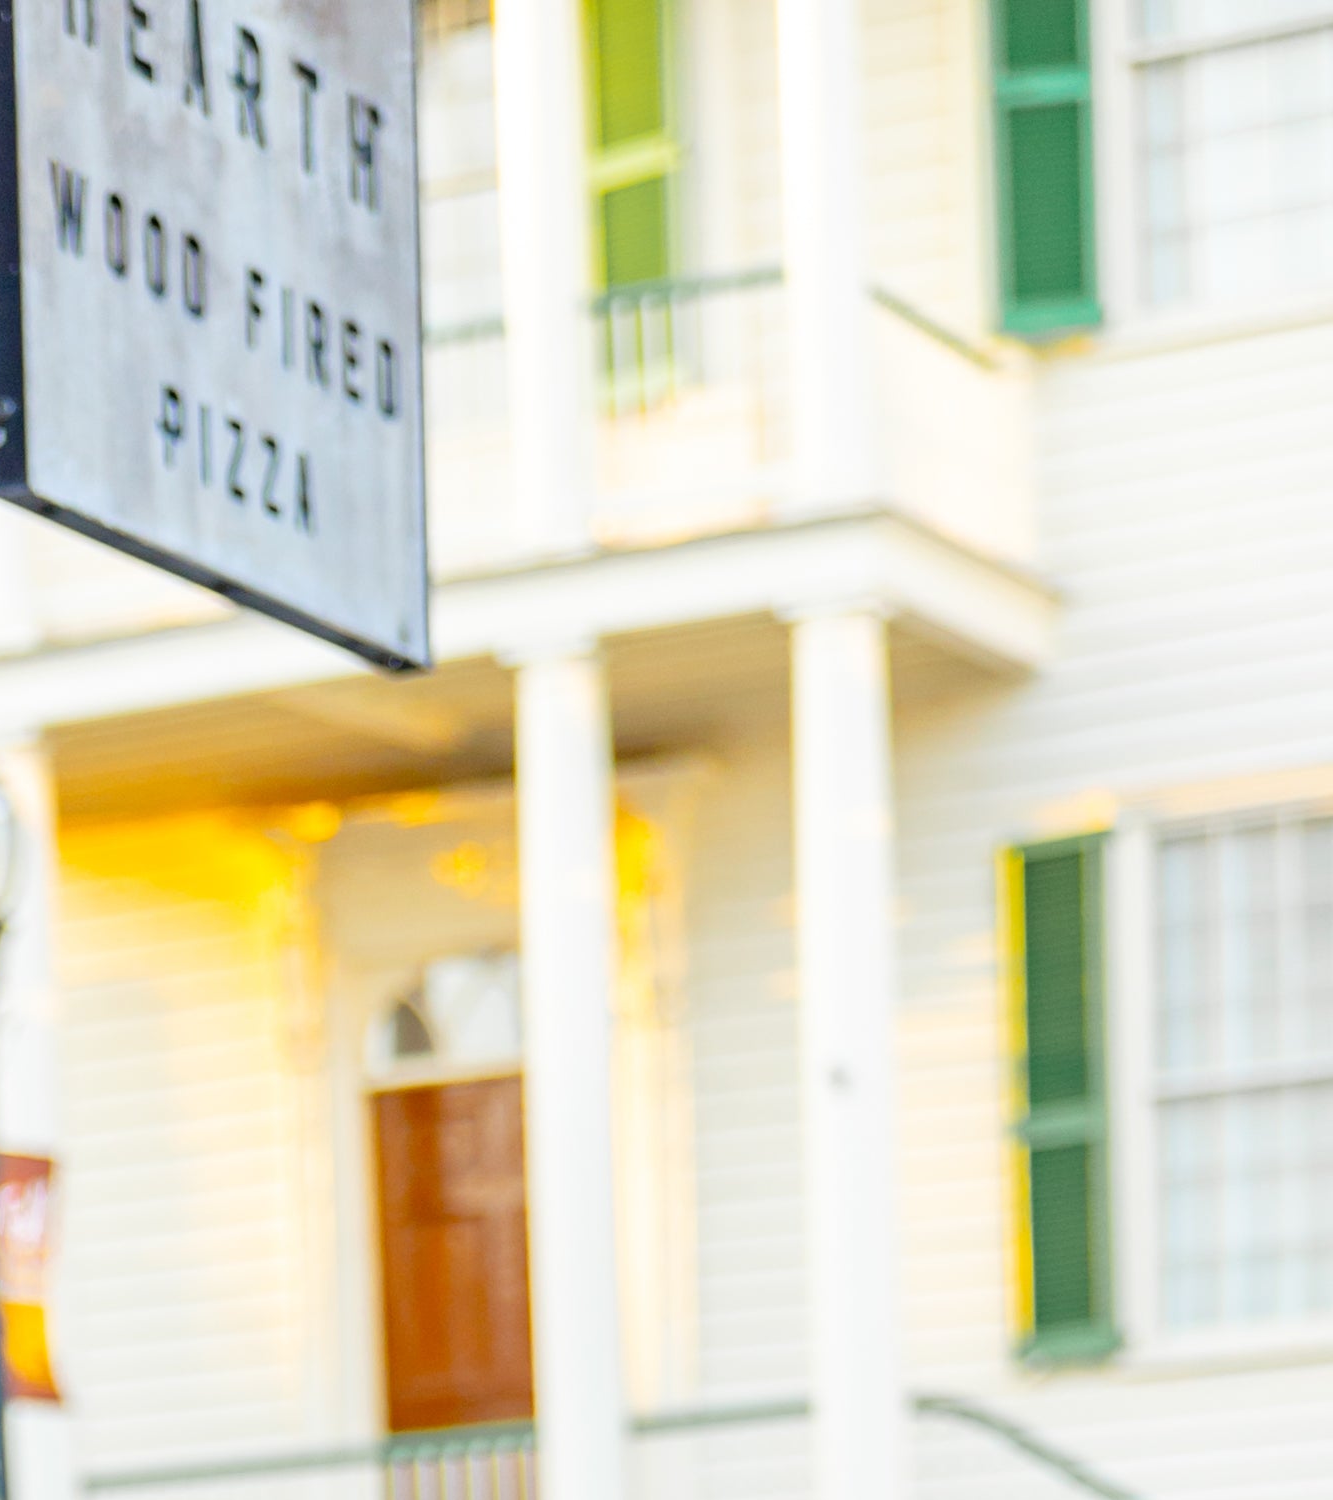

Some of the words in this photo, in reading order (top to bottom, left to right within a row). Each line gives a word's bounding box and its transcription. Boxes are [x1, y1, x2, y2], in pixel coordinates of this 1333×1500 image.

[49, 161, 204, 318] WOOD
[245, 267, 399, 420] FIRED
[158, 384, 314, 532] PIZZA
